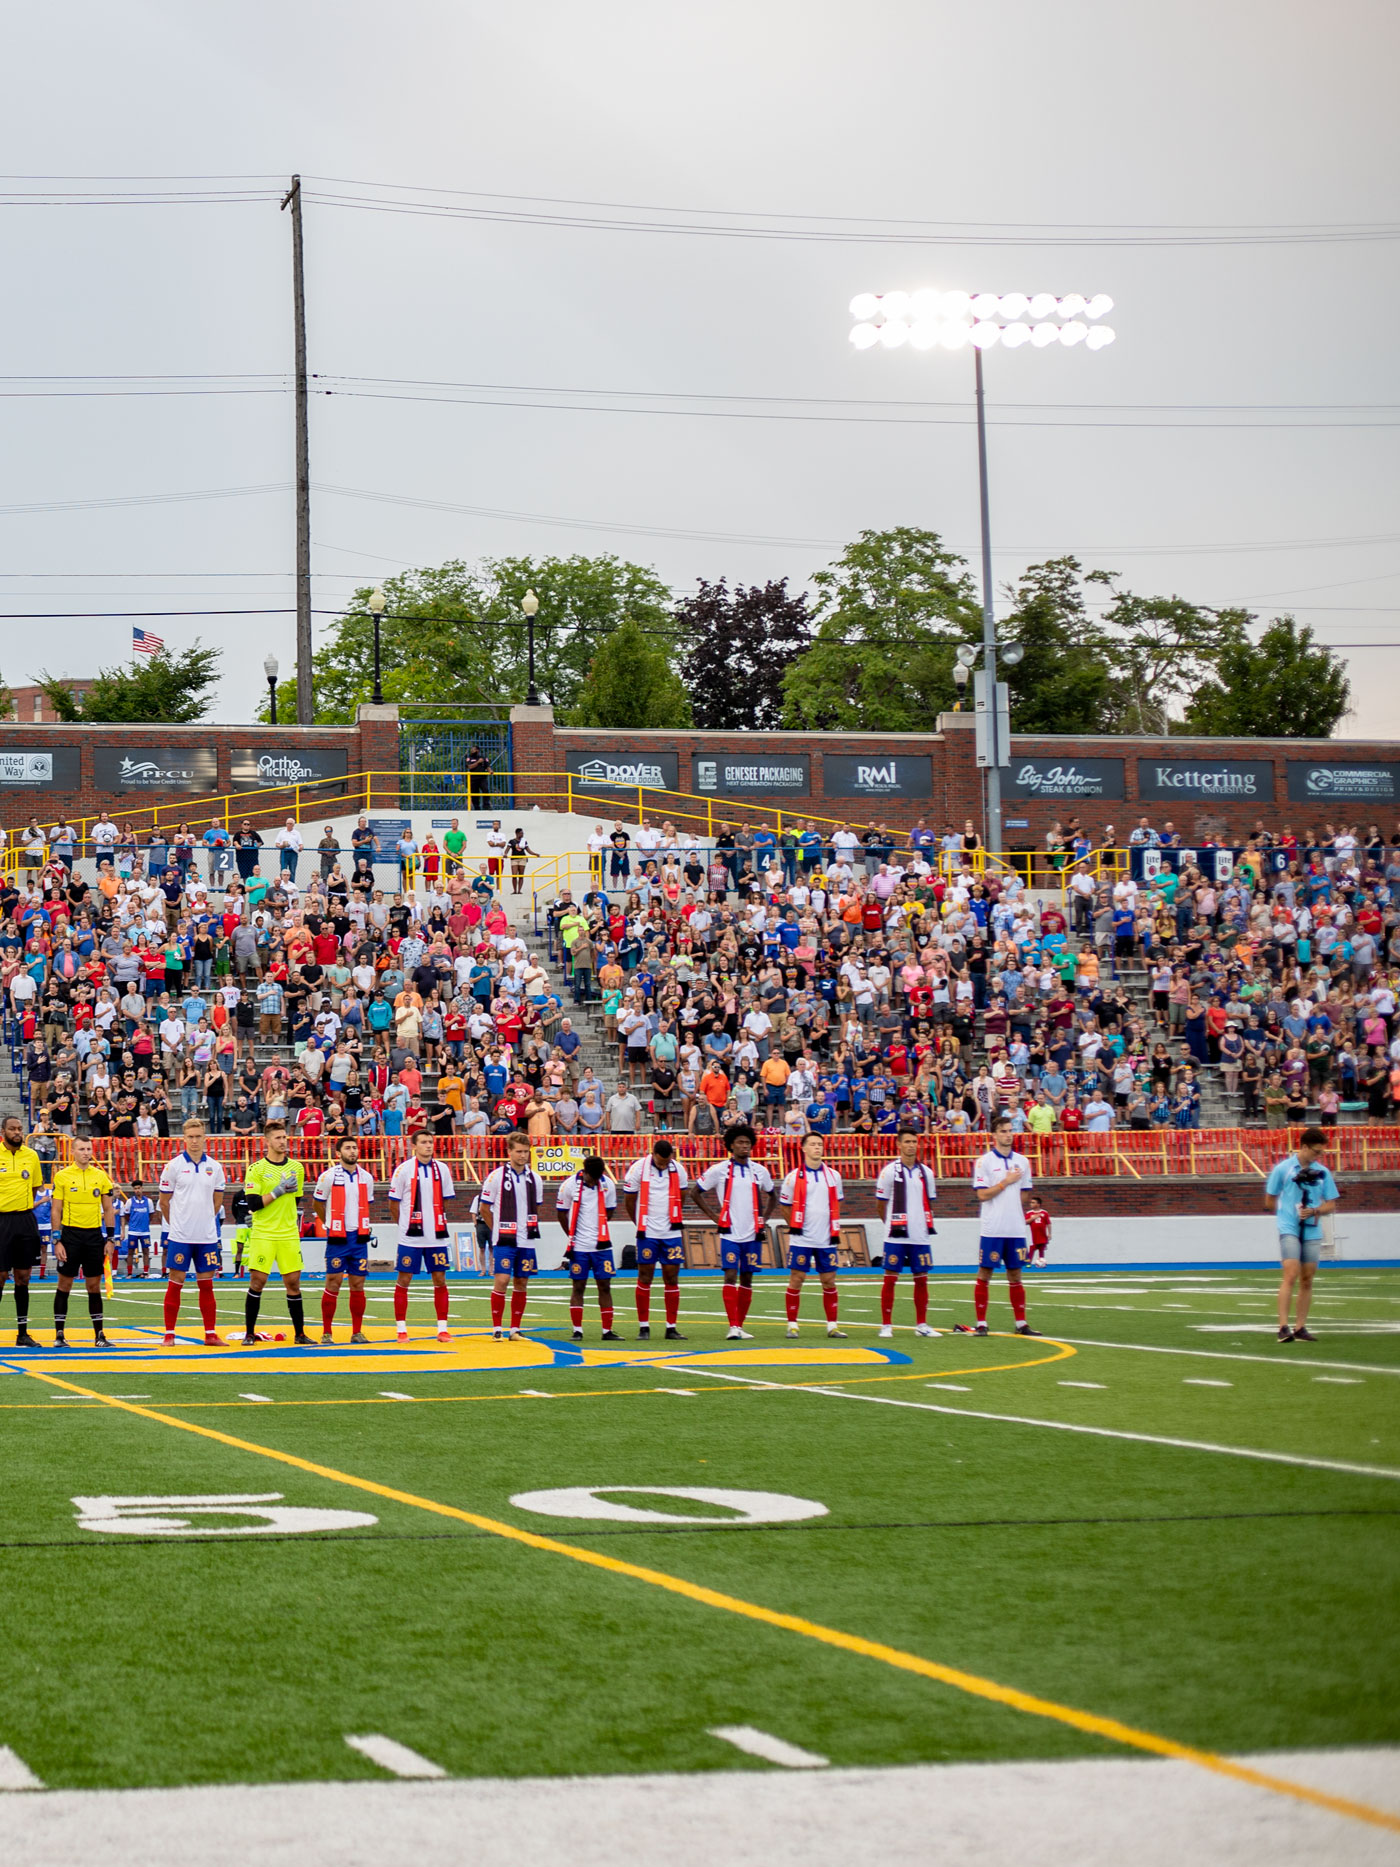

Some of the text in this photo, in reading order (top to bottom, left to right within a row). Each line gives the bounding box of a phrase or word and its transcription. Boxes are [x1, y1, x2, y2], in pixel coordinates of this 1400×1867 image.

[260, 755, 301, 769] Ortho
[4, 766, 25, 778] Way
[142, 770, 194, 778] PFCU
[606, 763, 662, 777] DOVER
[725, 766, 804, 782] GENESEE PACKAGING
[1333, 770, 1394, 778] COMMERCIAL
[1016, 764, 1102, 790] Big John
[1155, 767, 1257, 794] Kettering
[1202, 786, 1244, 794] UNIVERSITY
[219, 853, 229, 869] 2
[761, 854, 771, 869] 4
[1146, 855, 1160, 865] Lite
[1218, 855, 1232, 865] Lite
[1277, 853, 1286, 869] 6
[546, 1147, 563, 1158] GO
[537, 1161, 576, 1172] BUCKS!
[204, 1251, 218, 1266] 15
[432, 1252, 447, 1265] 13
[667, 1246, 682, 1260] 22
[745, 1253, 758, 1266] 12
[918, 1253, 932, 1266] 11
[603, 1260, 612, 1273] 8
[71, 1486, 831, 1536] 50
